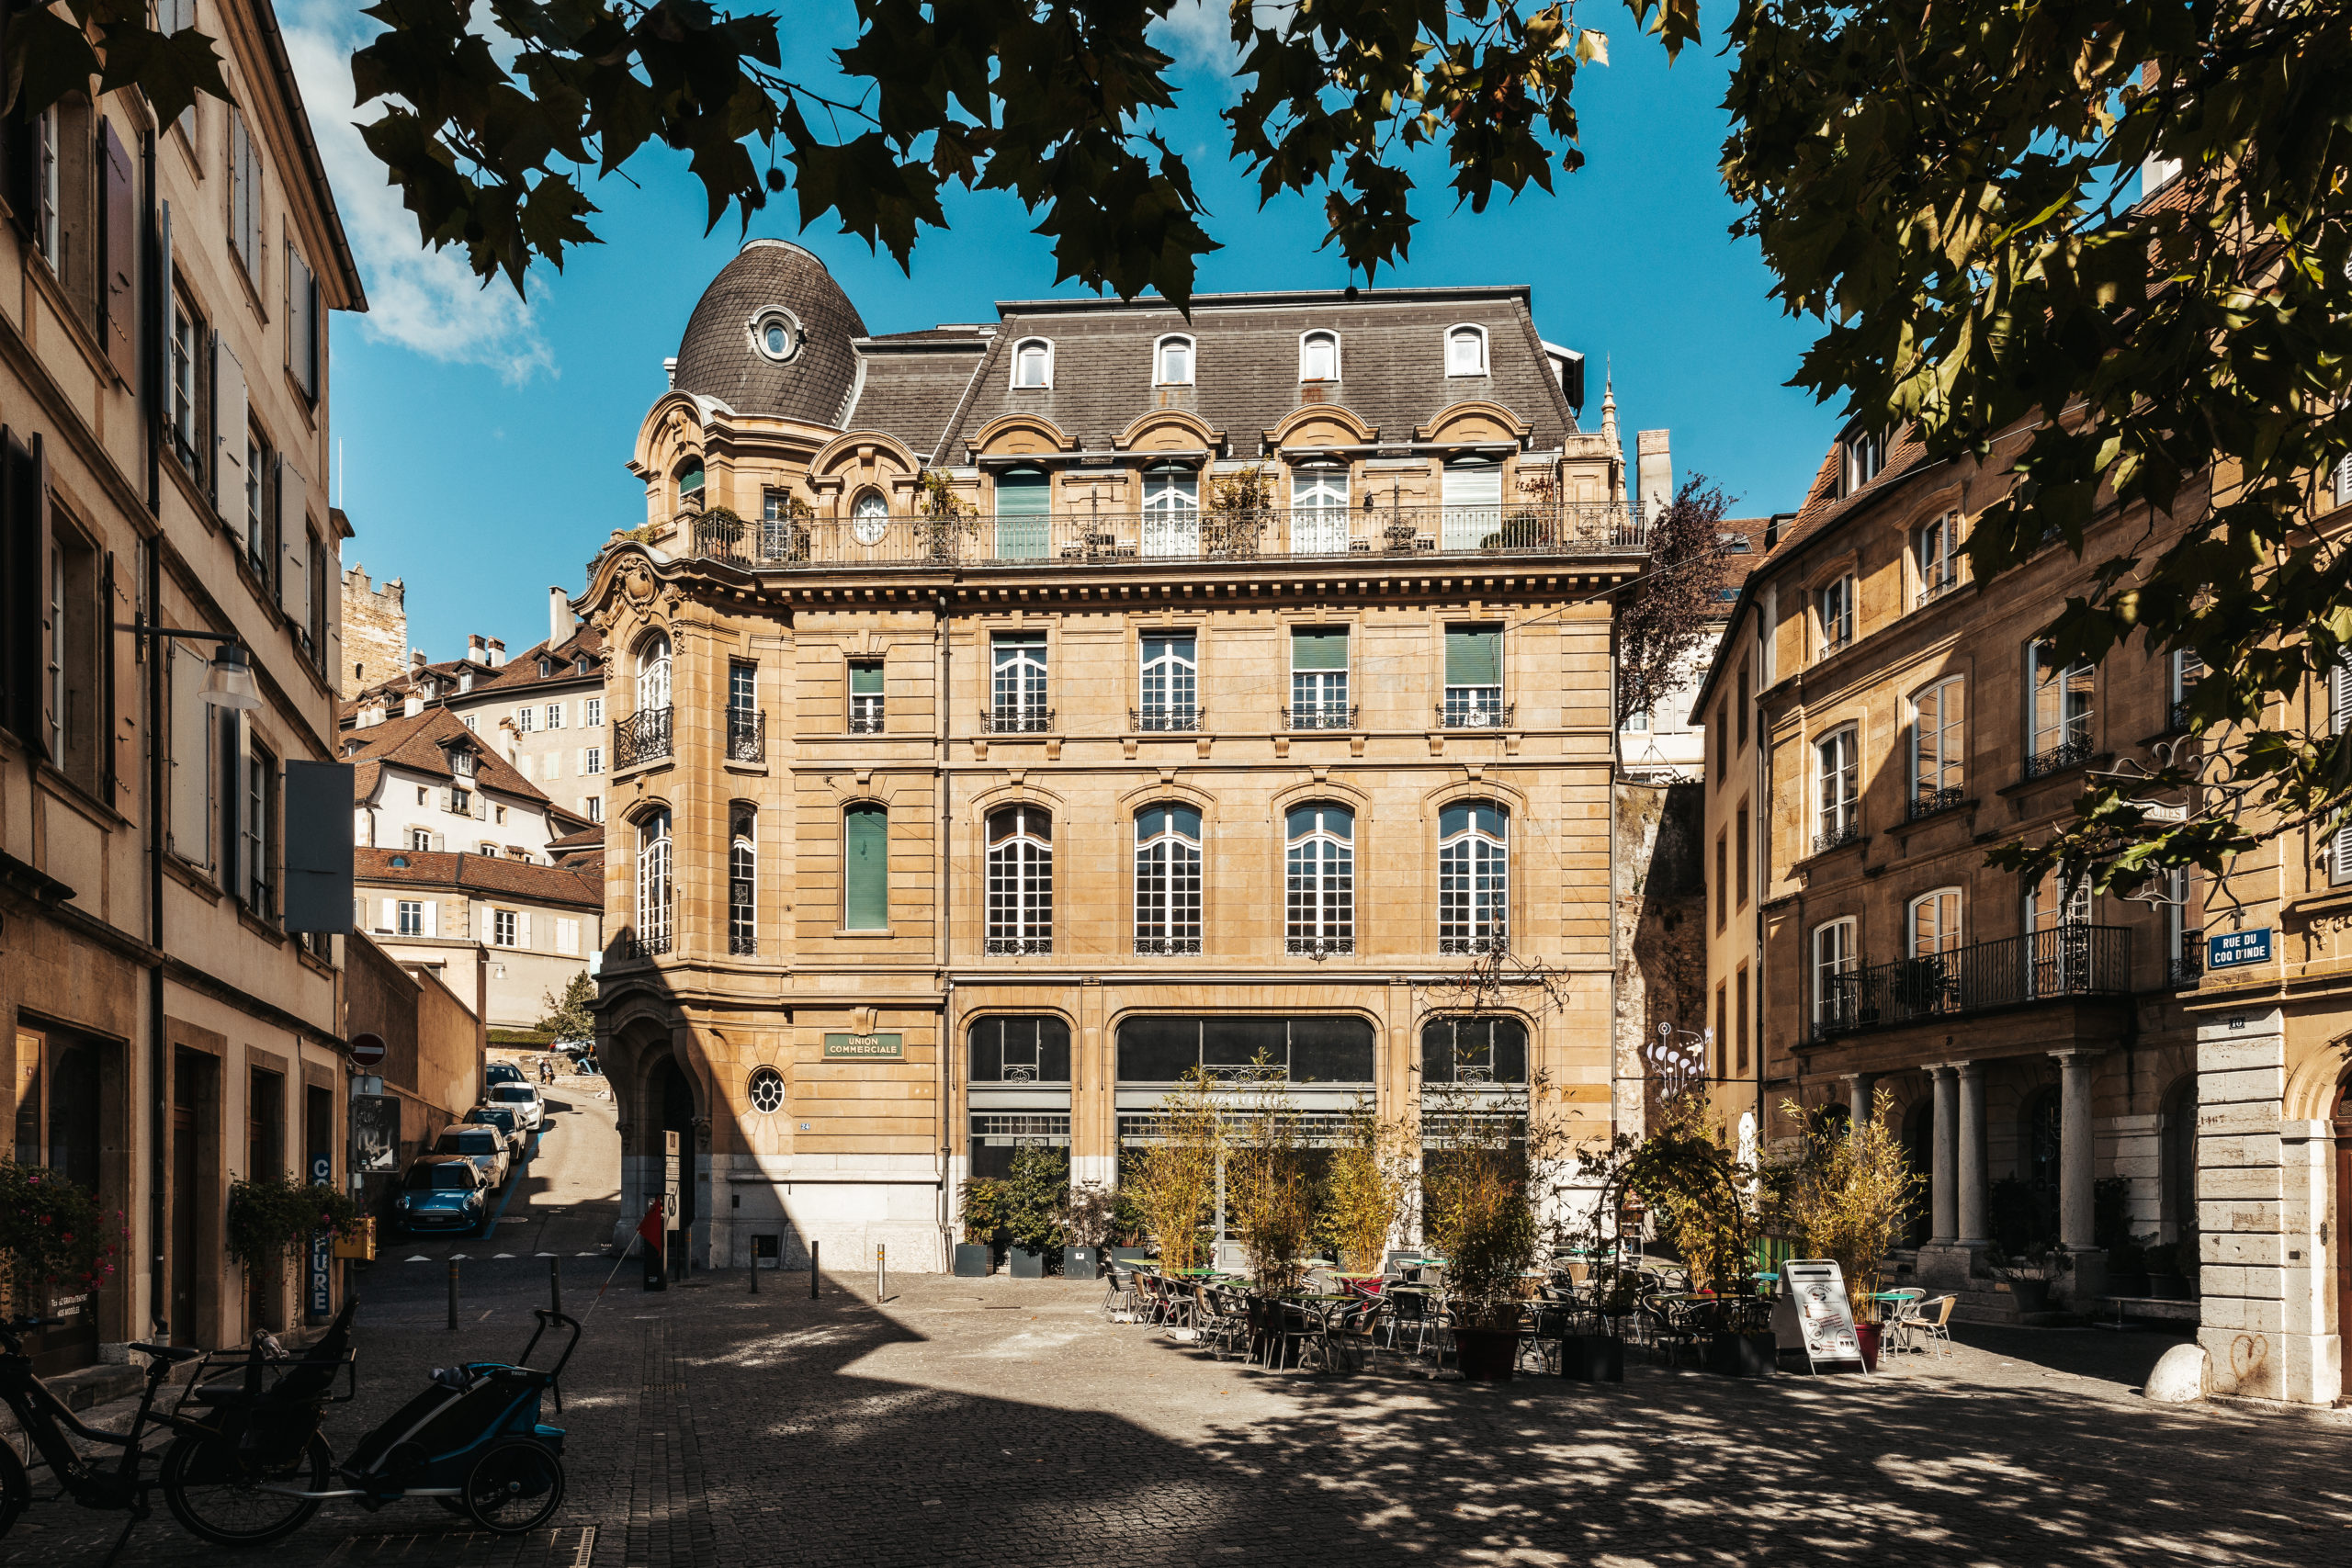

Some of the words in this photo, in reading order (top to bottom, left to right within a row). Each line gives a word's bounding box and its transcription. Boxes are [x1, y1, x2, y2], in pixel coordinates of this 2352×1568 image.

[2223, 936, 2241, 949] RUE
[2244, 933, 2256, 945] DU
[2214, 951, 2233, 963] COQ
[2235, 945, 2266, 960] D'INDE
[2232, 1019, 2243, 1028] 10
[830, 1045, 897, 1055] COMMERCIALE
